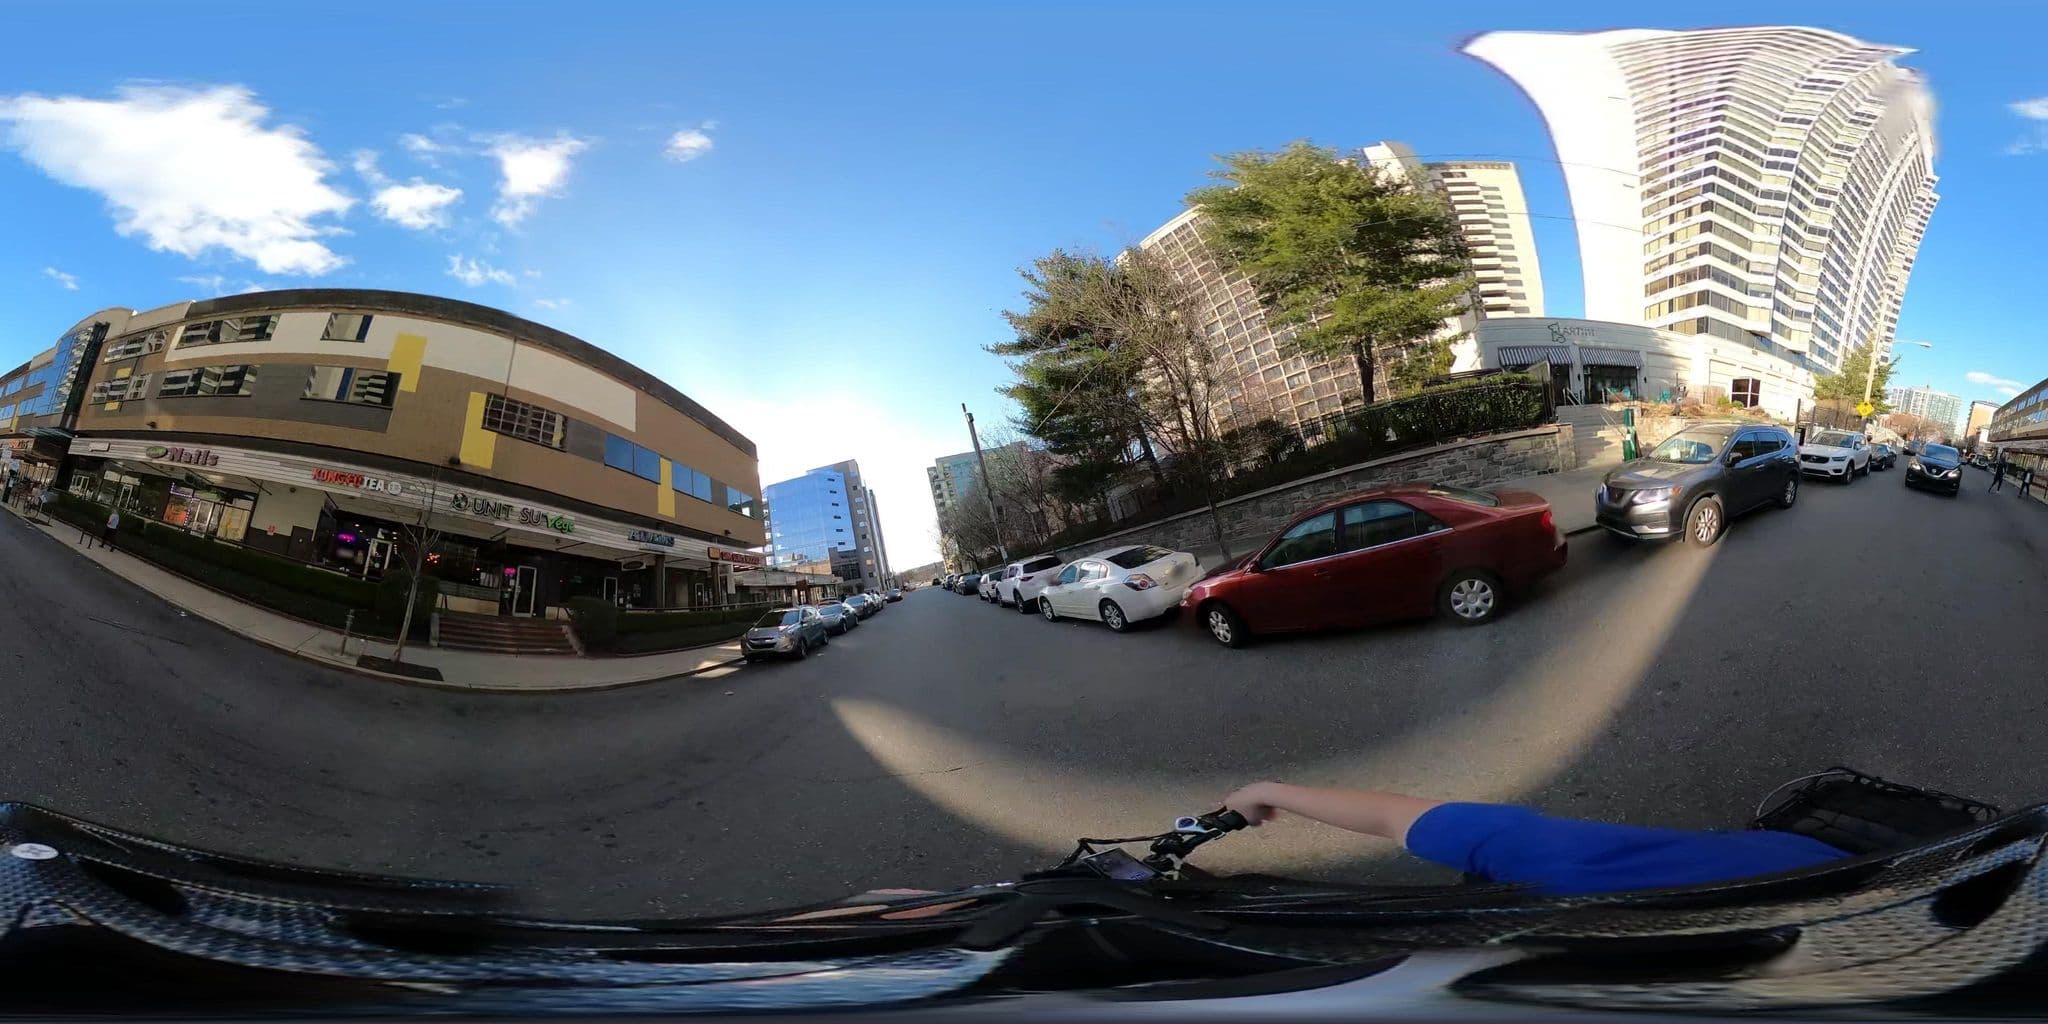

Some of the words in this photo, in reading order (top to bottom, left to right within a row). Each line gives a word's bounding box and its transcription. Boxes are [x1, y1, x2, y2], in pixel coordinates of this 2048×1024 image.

[168, 446, 219, 467] Nails
[362, 476, 385, 492] TEA
[472, 497, 514, 521] UNIT
[519, 507, 542, 527] SU
[543, 513, 576, 534] Vege
